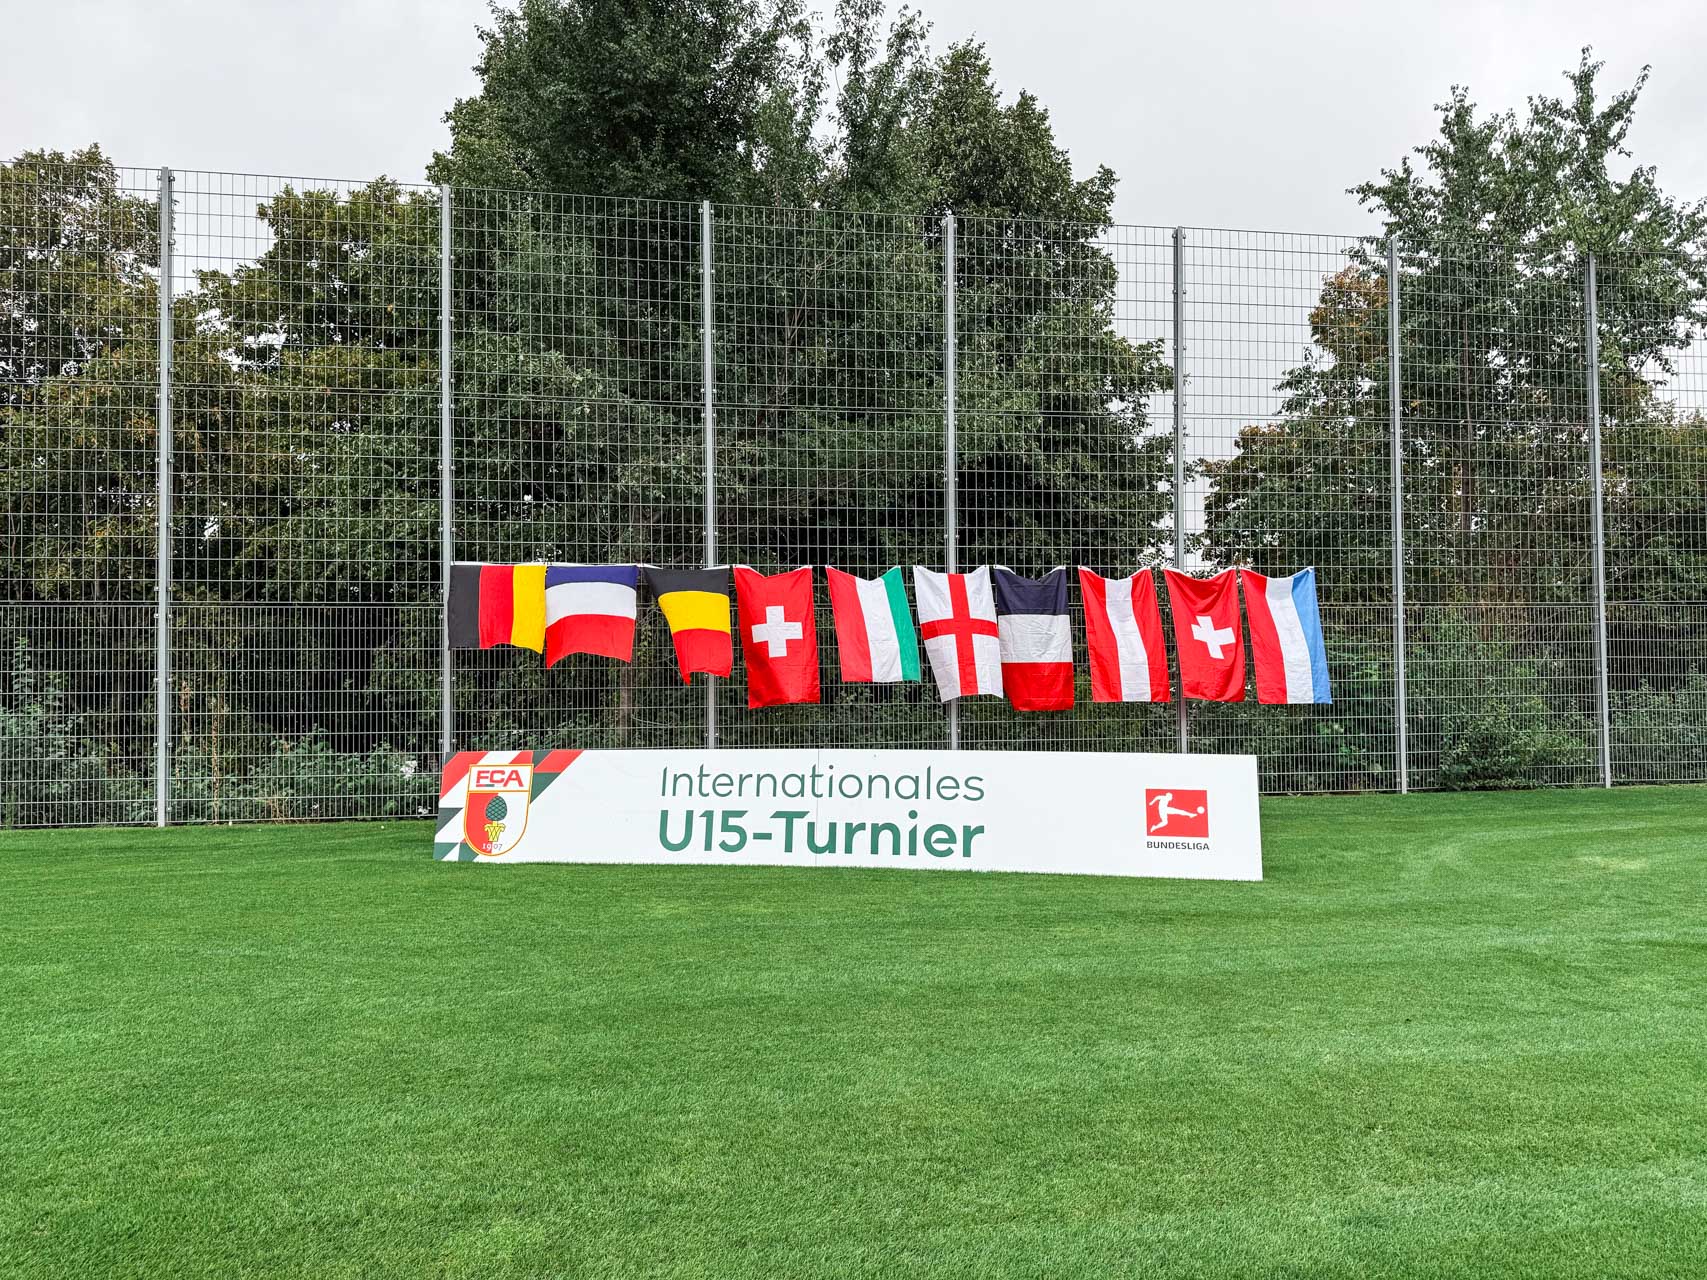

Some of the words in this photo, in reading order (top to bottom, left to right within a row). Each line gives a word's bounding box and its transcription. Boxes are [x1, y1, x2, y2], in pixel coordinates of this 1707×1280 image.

[476, 769, 524, 787] FCA
[661, 763, 985, 801] Internationales
[659, 809, 985, 858] U15-Turnier
[481, 843, 503, 851] 1907
[1146, 841, 1210, 851] BUNDESLIGA
